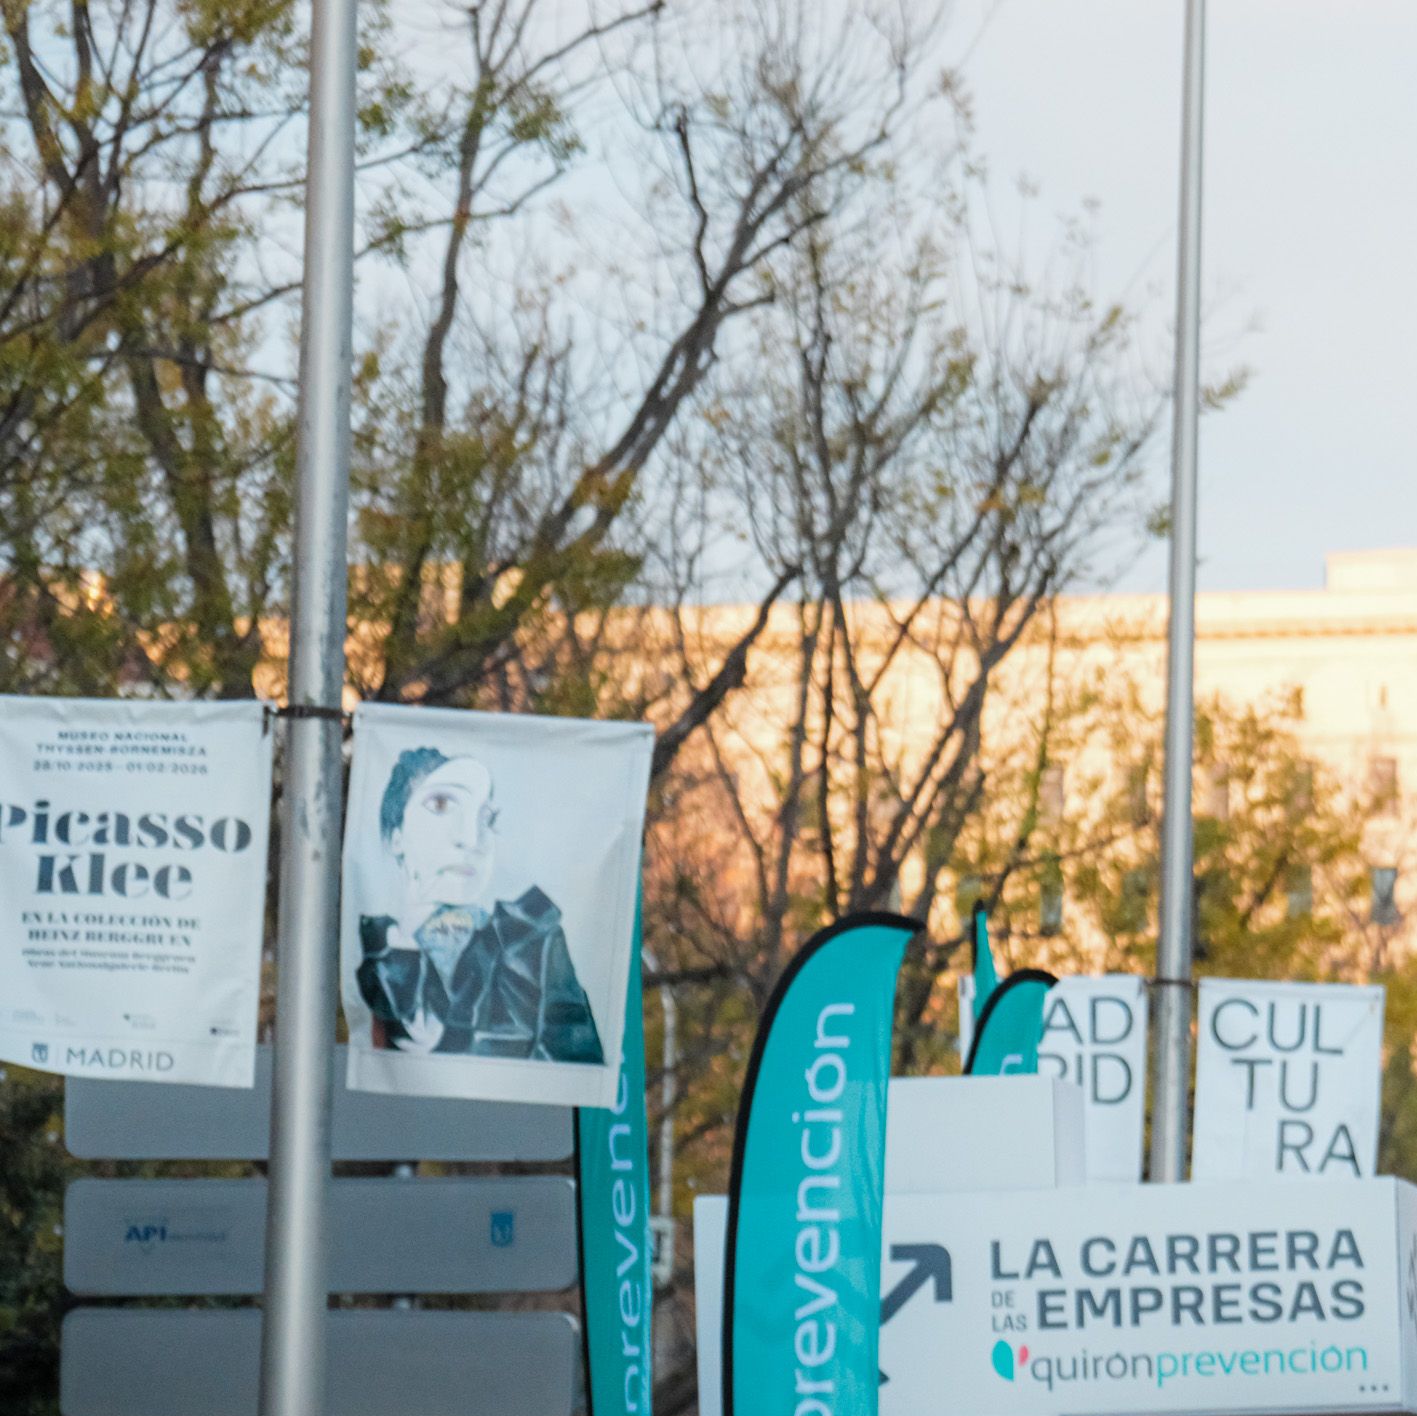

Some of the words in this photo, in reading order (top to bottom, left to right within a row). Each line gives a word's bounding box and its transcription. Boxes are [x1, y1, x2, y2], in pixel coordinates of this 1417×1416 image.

[35, 853, 193, 900] Klee
[1042, 995, 1134, 1047] AD
[1209, 997, 1345, 1057] CUL
[66, 1046, 175, 1072] MADRID
[1229, 1057, 1319, 1114] TU
[1275, 1119, 1362, 1178] RA
[125, 1226, 168, 1242] API
[990, 1237, 1063, 1281] LA
[1079, 1227, 1366, 1278] CARRERA
[991, 1290, 1015, 1308] DE
[991, 1315, 1028, 1334] LAS
[1036, 1278, 1366, 1330] EMPRESAS
[1030, 1340, 1369, 1393] quirónprevención
